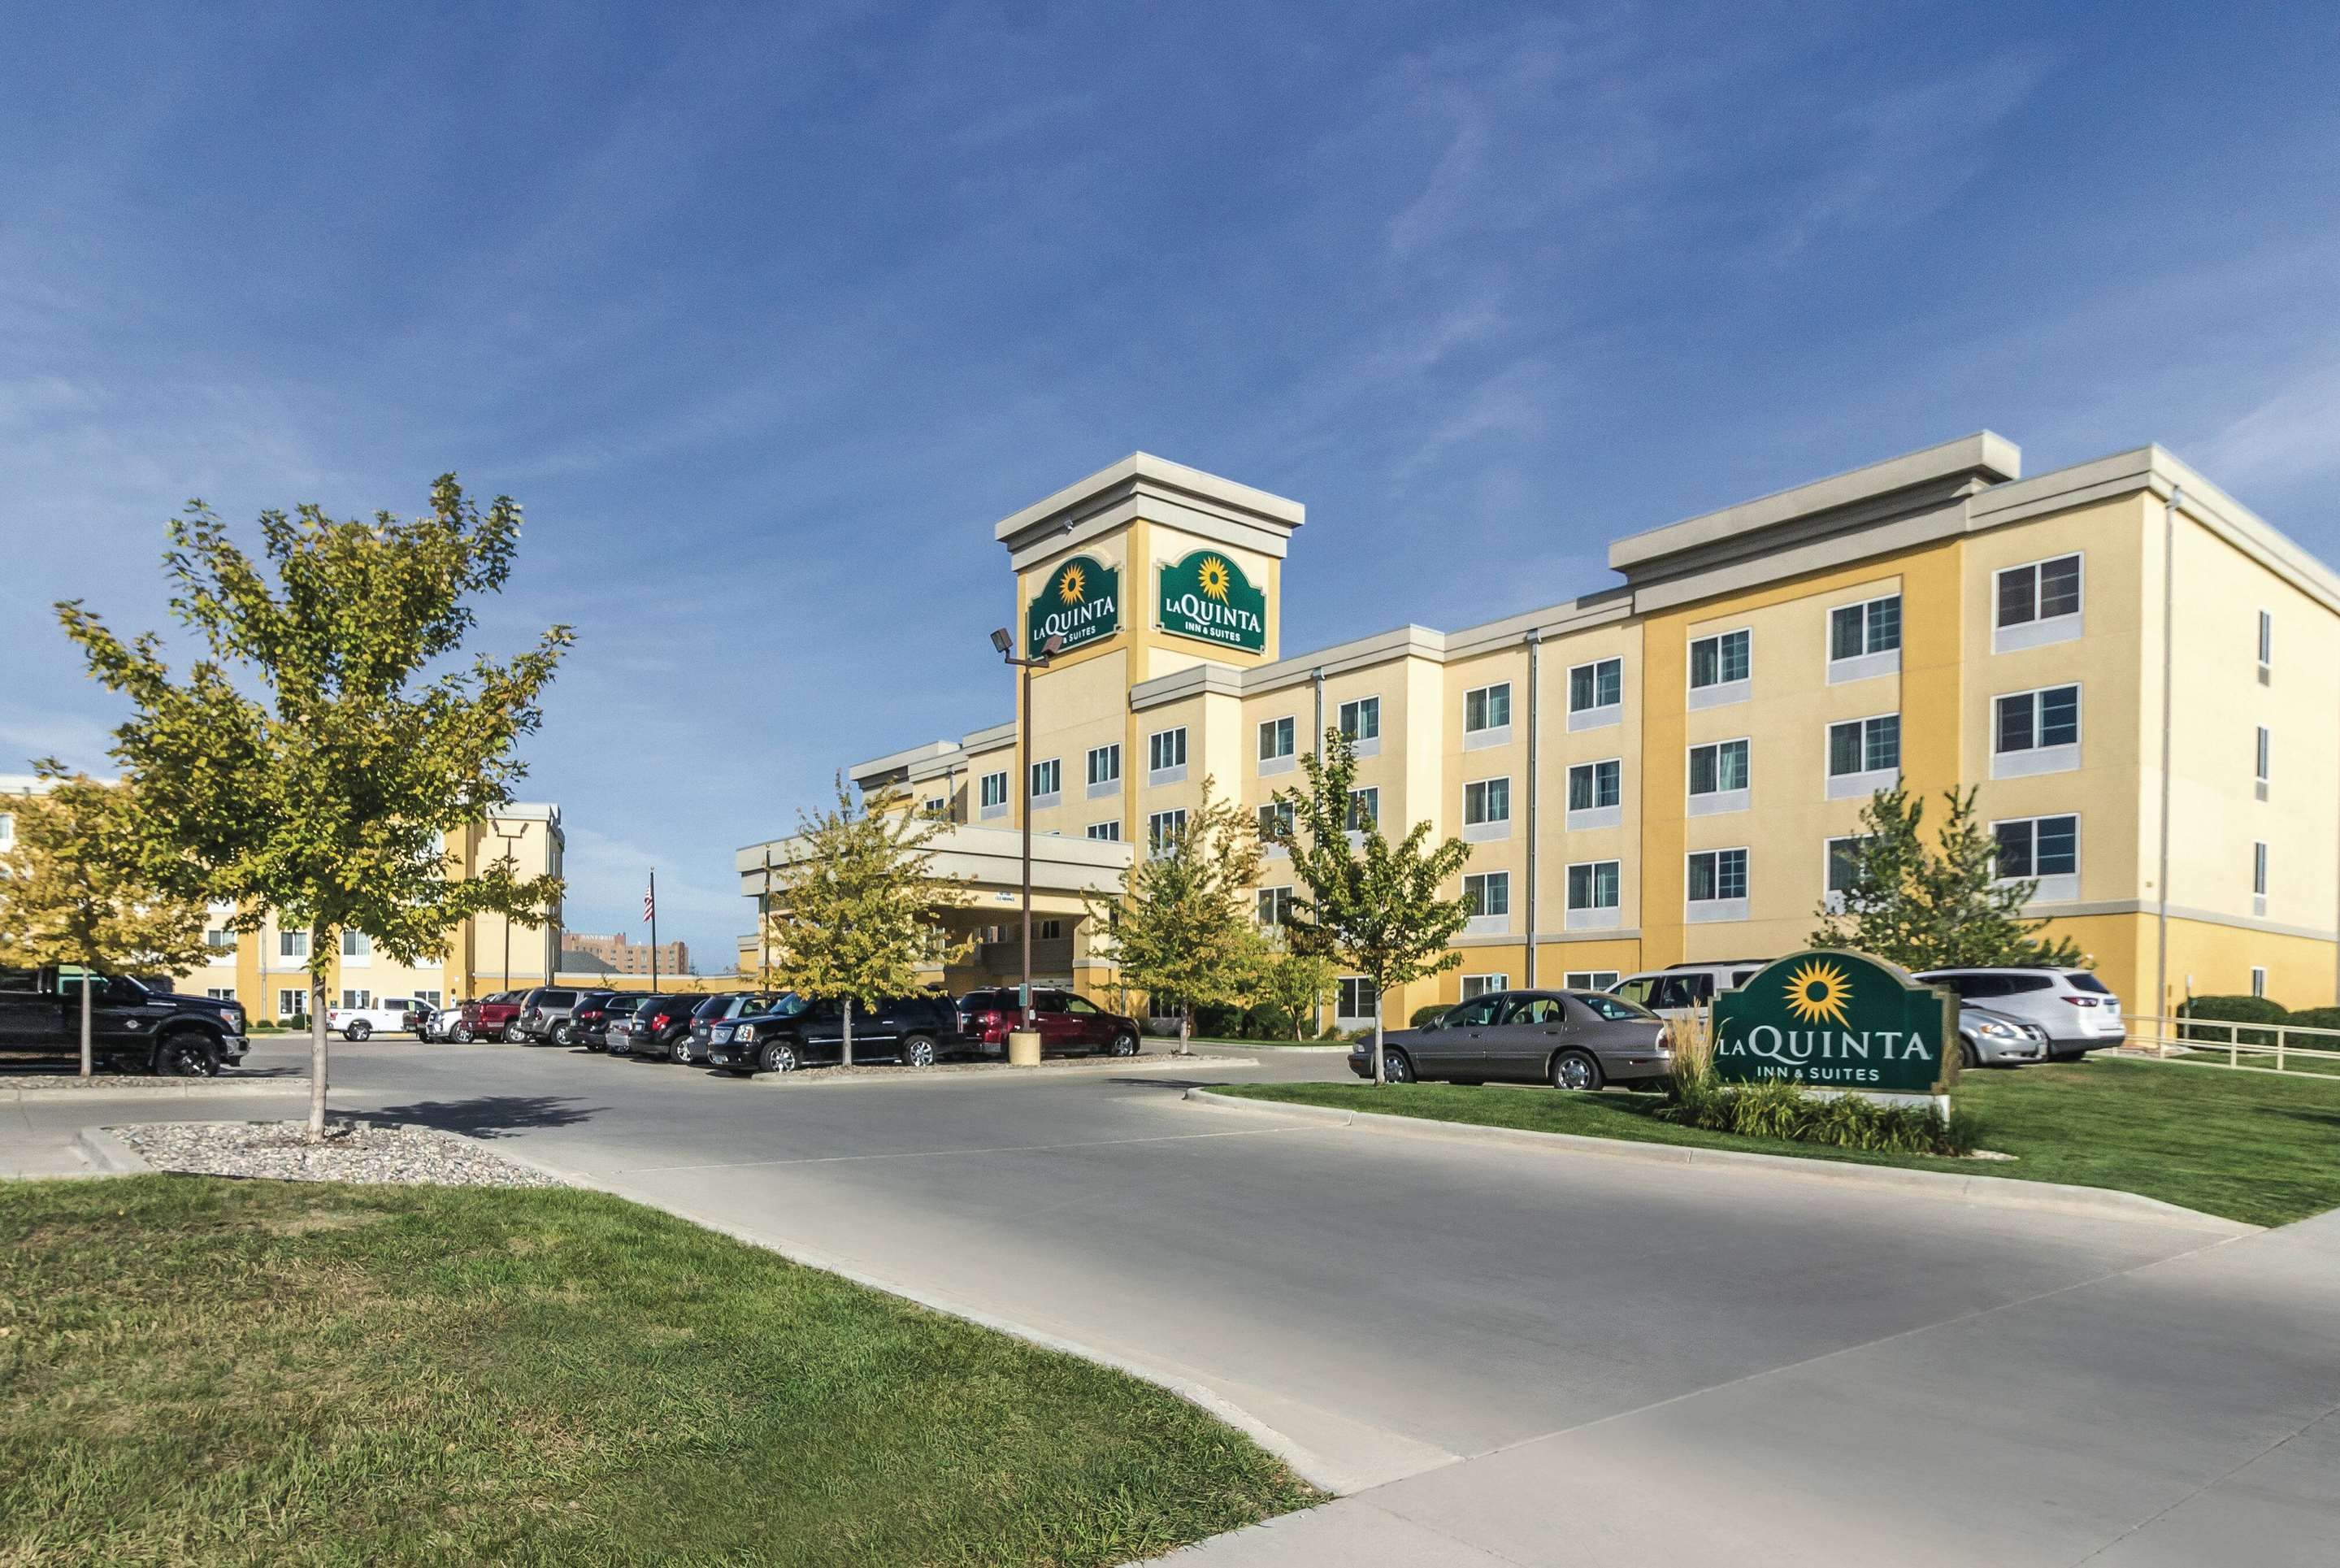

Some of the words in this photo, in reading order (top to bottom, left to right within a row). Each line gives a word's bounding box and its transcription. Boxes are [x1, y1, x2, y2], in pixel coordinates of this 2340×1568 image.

[1069, 625, 1096, 642] SUITES
[1185, 621, 1201, 632] INN
[1209, 628, 1240, 642] SUITES
[1757, 1066, 1787, 1077] INN
[1795, 1069, 1803, 1078] &
[1810, 1067, 1879, 1081] SUITES
